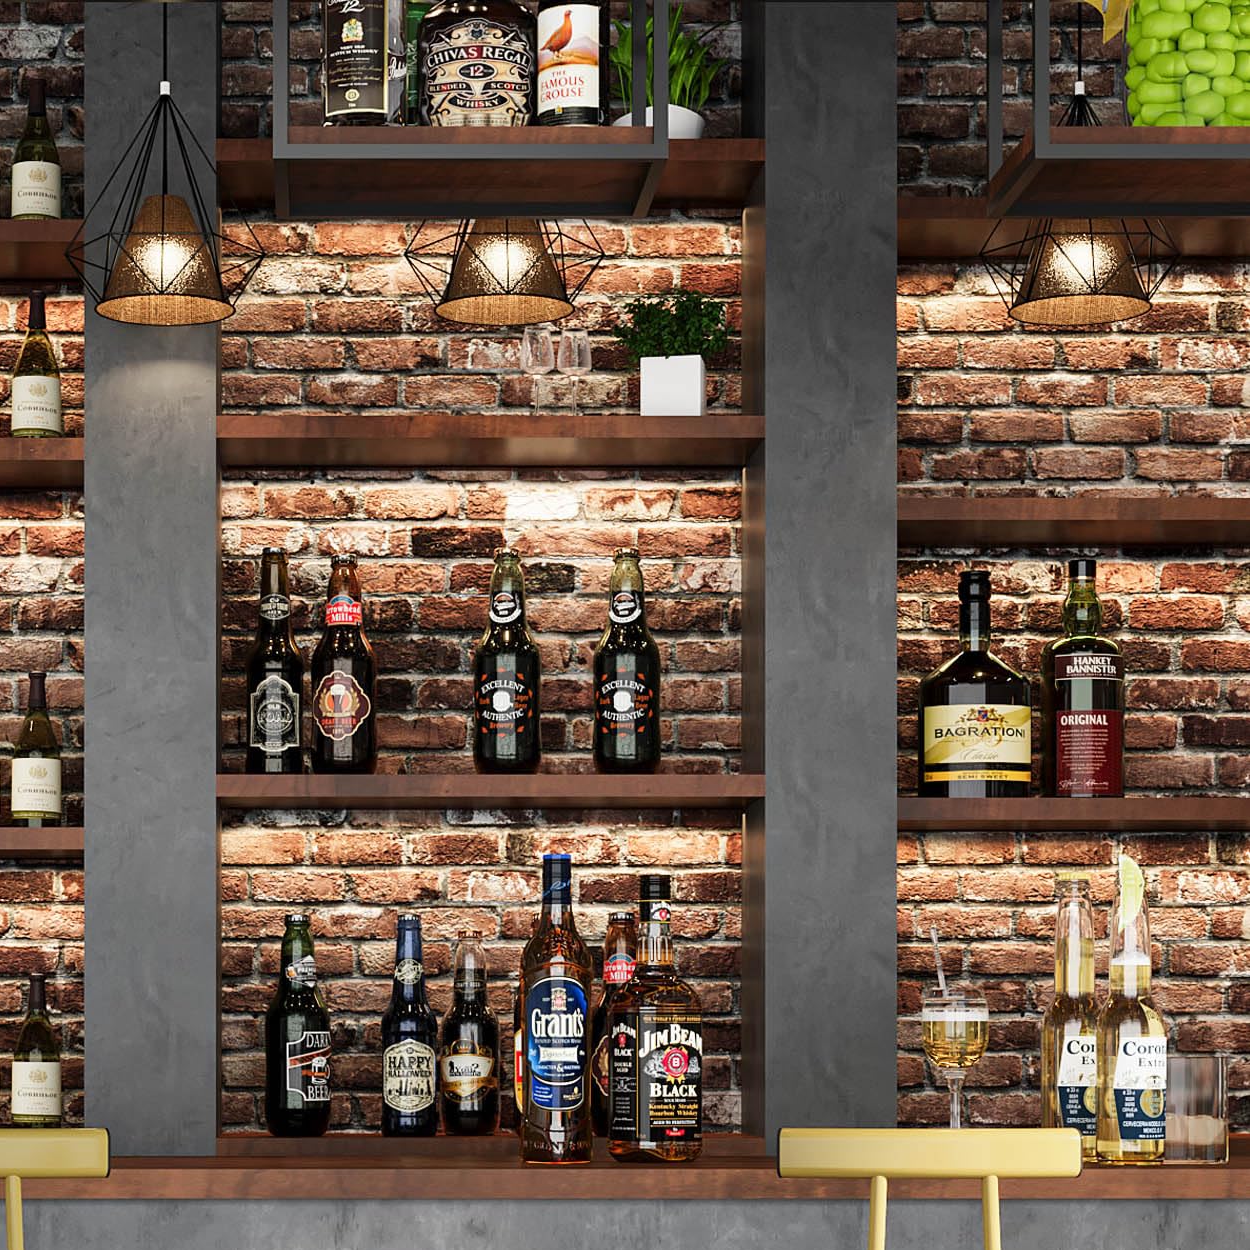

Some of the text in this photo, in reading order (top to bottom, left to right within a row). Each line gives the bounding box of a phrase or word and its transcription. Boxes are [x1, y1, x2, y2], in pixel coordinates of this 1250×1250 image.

[427, 46, 478, 68] CHIVAS
[482, 46, 528, 67] REGAL
[469, 65, 484, 77] 12
[430, 82, 527, 91] BLENDED SCOTCH
[541, 76, 585, 89] FAMOUS
[541, 87, 583, 102] GROUSE
[455, 98, 499, 108] WHISKY
[332, 613, 353, 622] Mills
[1073, 656, 1111, 665] HANKEY
[1066, 664, 1117, 674] BANNISTER
[481, 680, 525, 694] EXCELLENT
[601, 680, 645, 694] EXCELLENT
[482, 708, 524, 721] AUTHENTIC
[602, 708, 645, 721] AUTHENTIC
[1060, 714, 1108, 726] ORIGINAL
[934, 726, 1025, 739] BAGRATIONI
[531, 1008, 584, 1038] Grant's
[619, 1023, 636, 1038] BEAM
[639, 1029, 669, 1058] JIM
[614, 1048, 632, 1056] BLACK
[388, 1056, 431, 1069] HAPPY
[556, 1063, 564, 1073] &
[650, 1083, 698, 1098] BLACK
